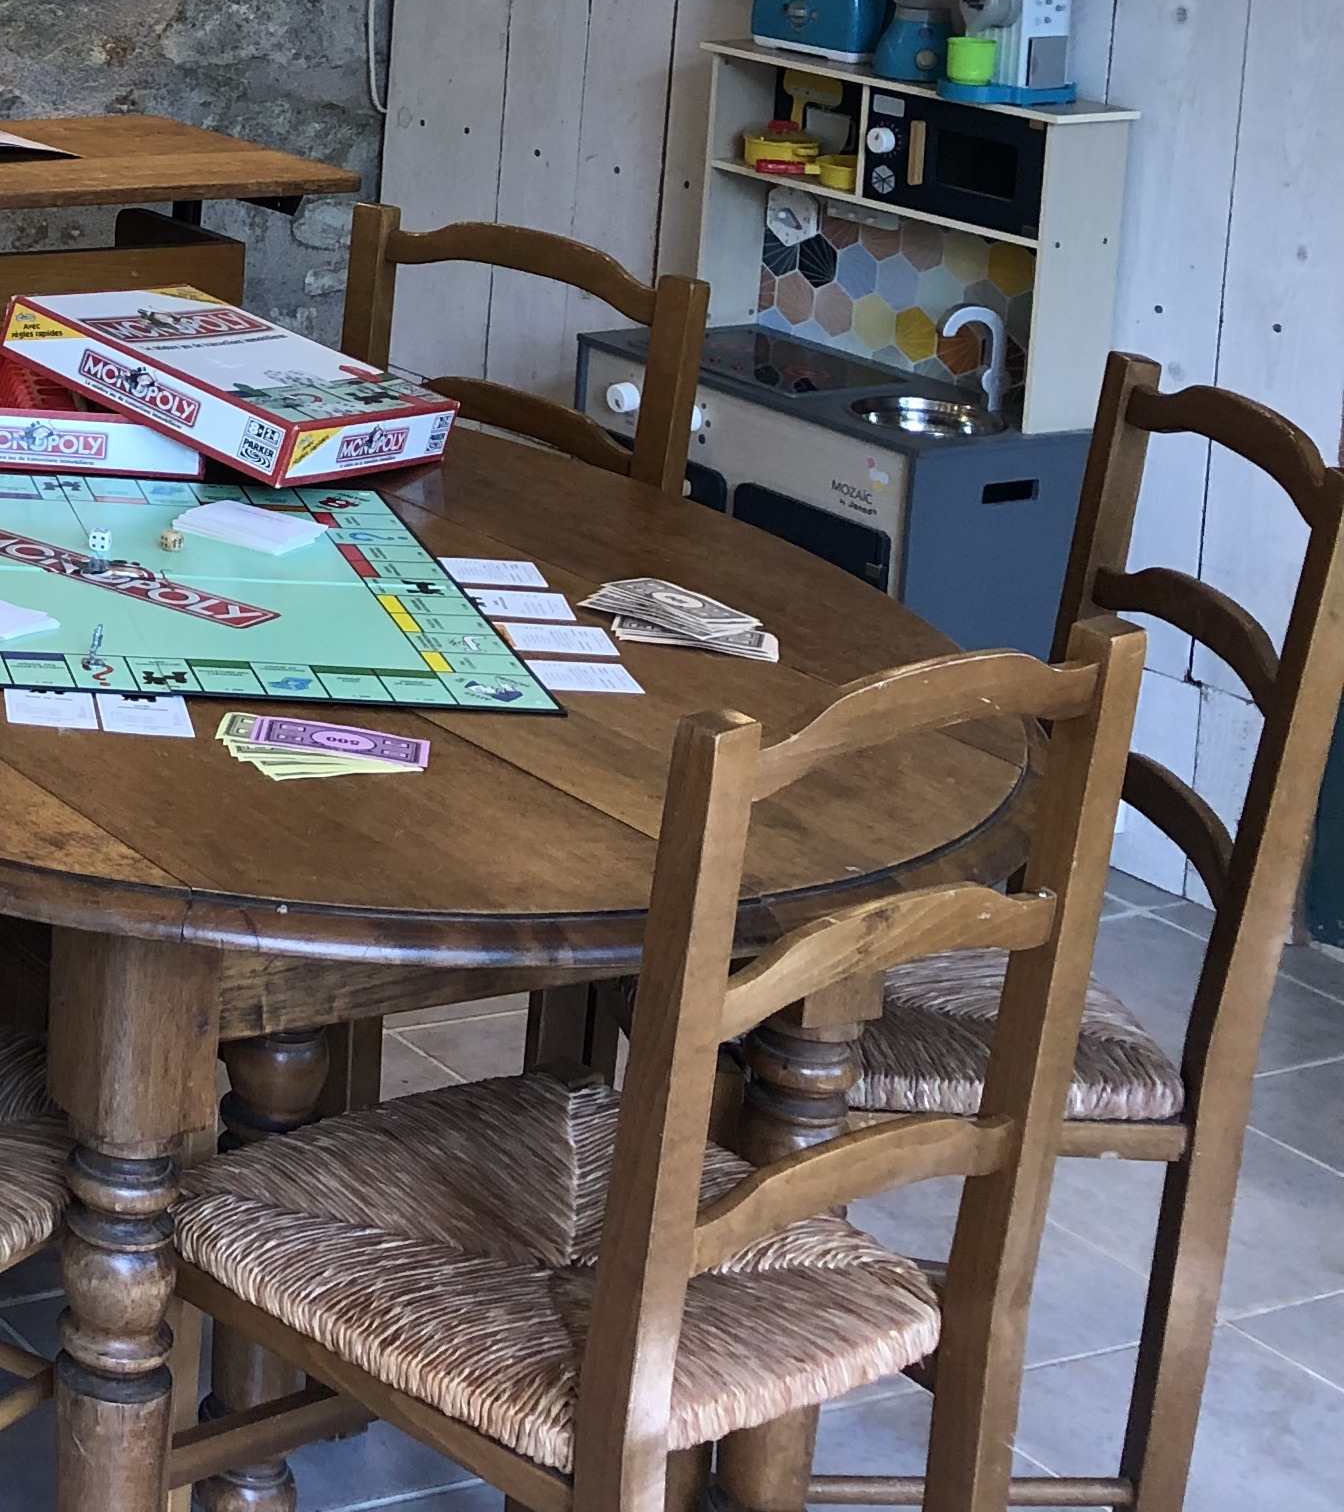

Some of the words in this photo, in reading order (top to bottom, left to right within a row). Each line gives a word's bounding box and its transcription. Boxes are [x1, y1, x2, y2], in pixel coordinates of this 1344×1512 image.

[11, 330, 34, 339] règles
[35, 328, 64, 338] rapides
[23, 322, 41, 330] Avec
[84, 355, 195, 419] MONOPOLY
[243, 437, 275, 459] PARKER
[340, 432, 405, 458] MONOPOLY
